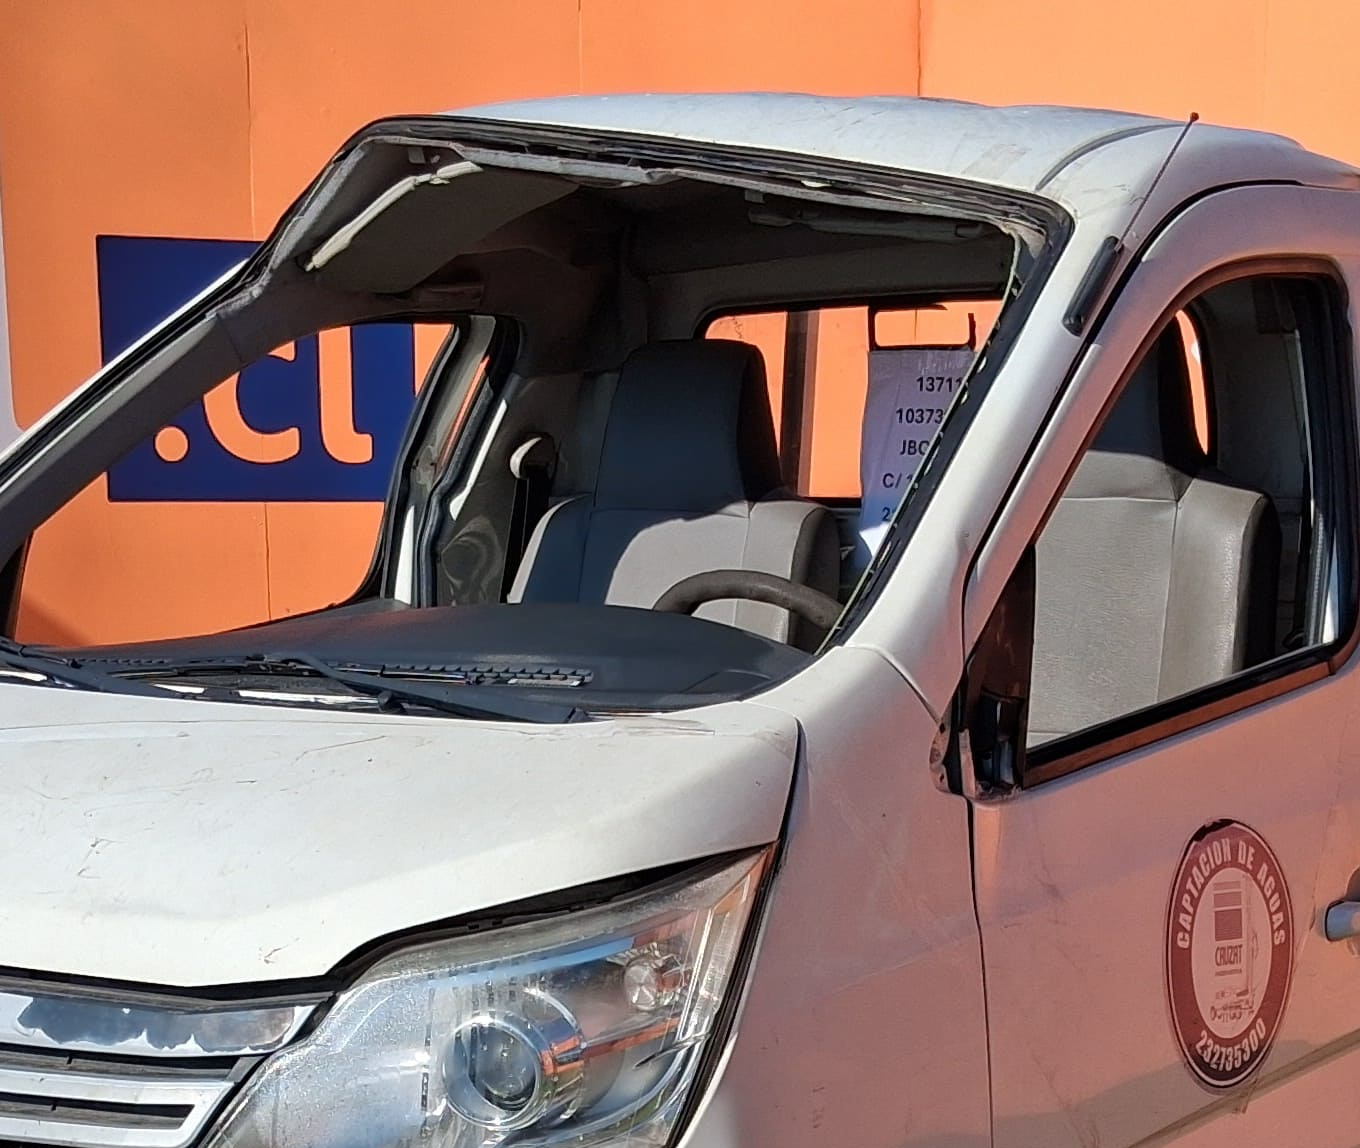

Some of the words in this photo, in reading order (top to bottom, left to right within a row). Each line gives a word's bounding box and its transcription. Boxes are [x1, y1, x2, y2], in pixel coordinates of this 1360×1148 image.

[895, 408, 945, 425] 10373
[1176, 838, 1232, 949] CAPTACION
[1238, 839, 1256, 871] DE
[1256, 861, 1286, 946] AGUAS
[1215, 944, 1243, 967] CRUZAT
